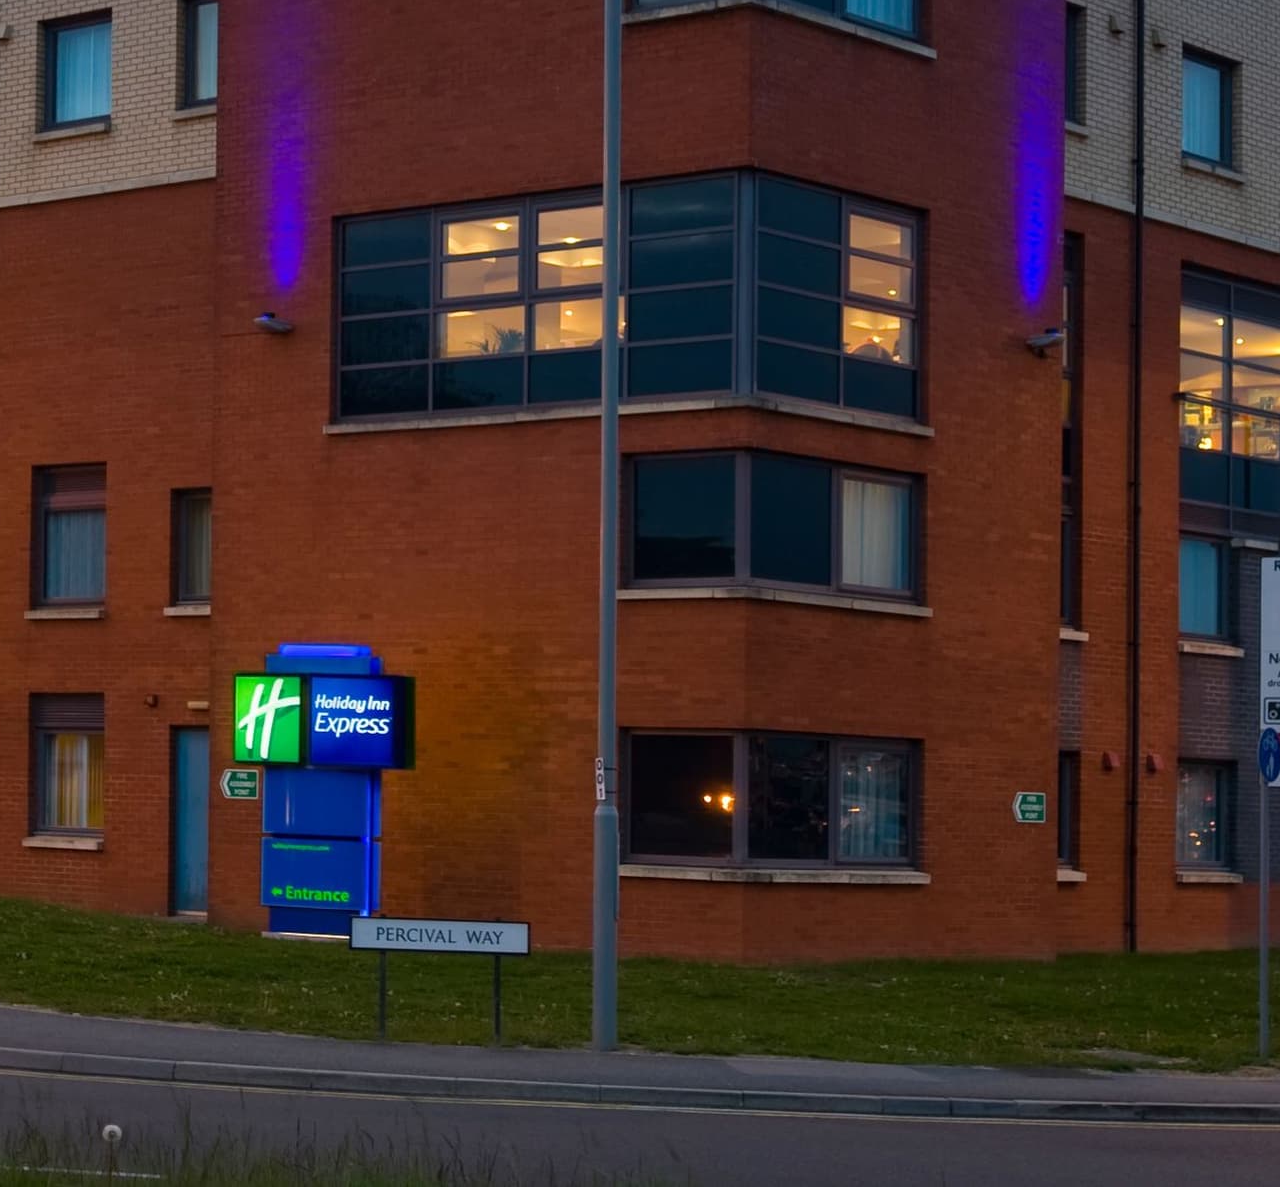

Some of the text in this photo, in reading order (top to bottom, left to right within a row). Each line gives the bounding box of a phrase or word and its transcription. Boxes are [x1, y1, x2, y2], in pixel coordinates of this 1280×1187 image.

[315, 694, 390, 713] Holiday Inn
[314, 712, 390, 738] Express
[285, 886, 350, 902] Entrance
[376, 927, 504, 945] PERCIVAL WAY
